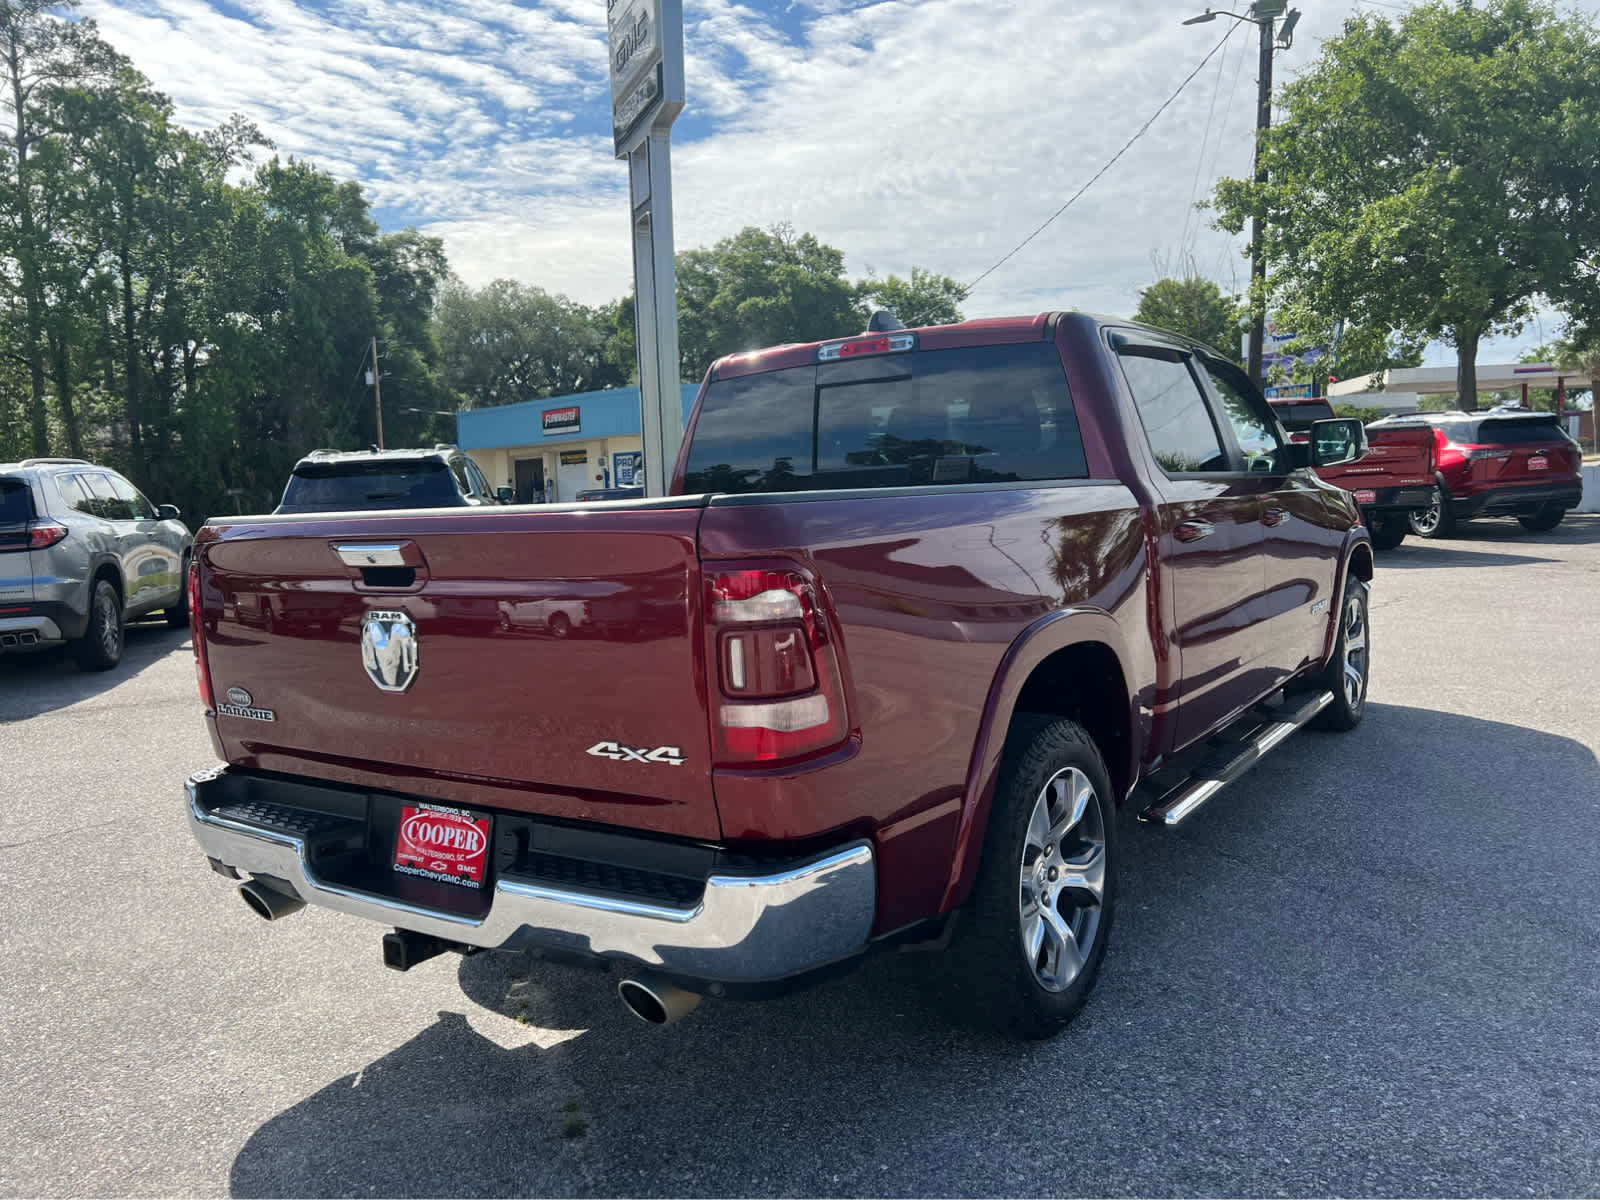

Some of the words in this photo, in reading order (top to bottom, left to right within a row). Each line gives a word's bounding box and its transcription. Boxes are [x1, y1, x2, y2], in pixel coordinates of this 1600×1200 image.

[370, 612, 402, 620] RAM
[218, 703, 274, 722] LARAMIE
[585, 741, 688, 766] 4x4
[461, 809, 471, 817] SC
[407, 820, 479, 852] COOPER
[416, 847, 456, 862] WALTERBORO,
[457, 854, 465, 862] SC
[394, 864, 479, 888] CooperChevyGMC.com
[457, 864, 477, 874] GMC
